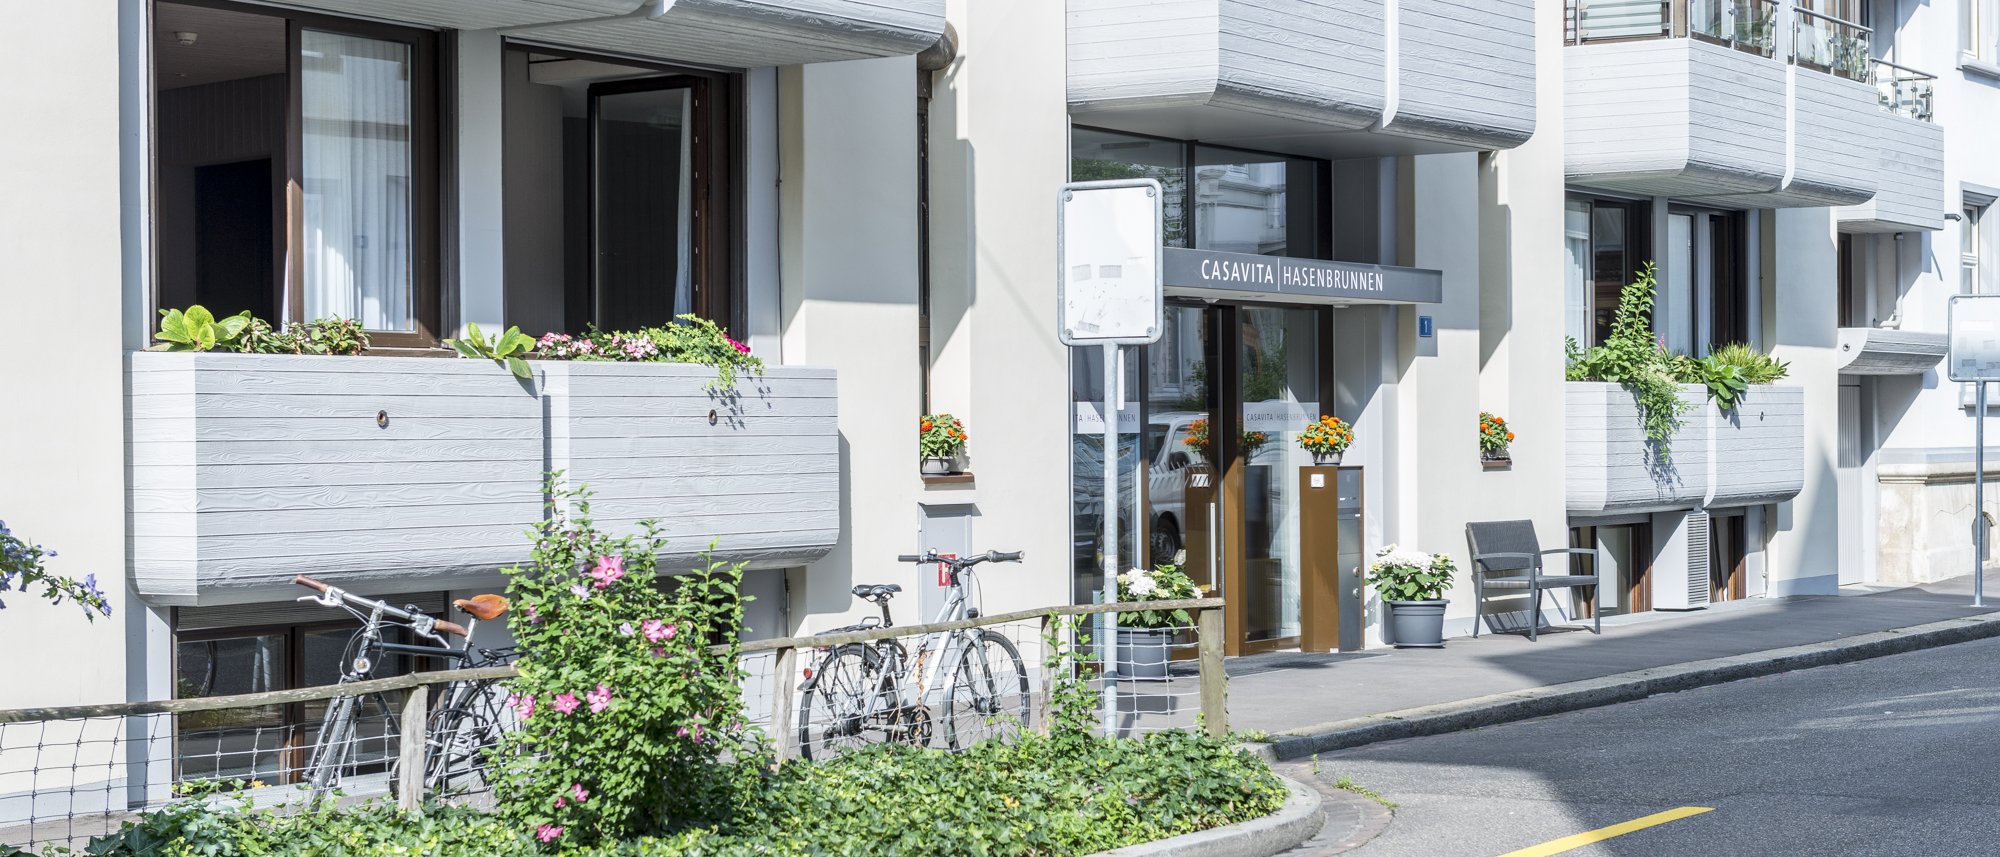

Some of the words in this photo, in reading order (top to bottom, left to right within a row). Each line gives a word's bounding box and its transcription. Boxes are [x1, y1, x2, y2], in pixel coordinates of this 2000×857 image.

[1201, 259, 1274, 284] CASAVITA
[1283, 266, 1383, 292] HASENBRUNNEN
[1246, 413, 1274, 422] CASAVITA
